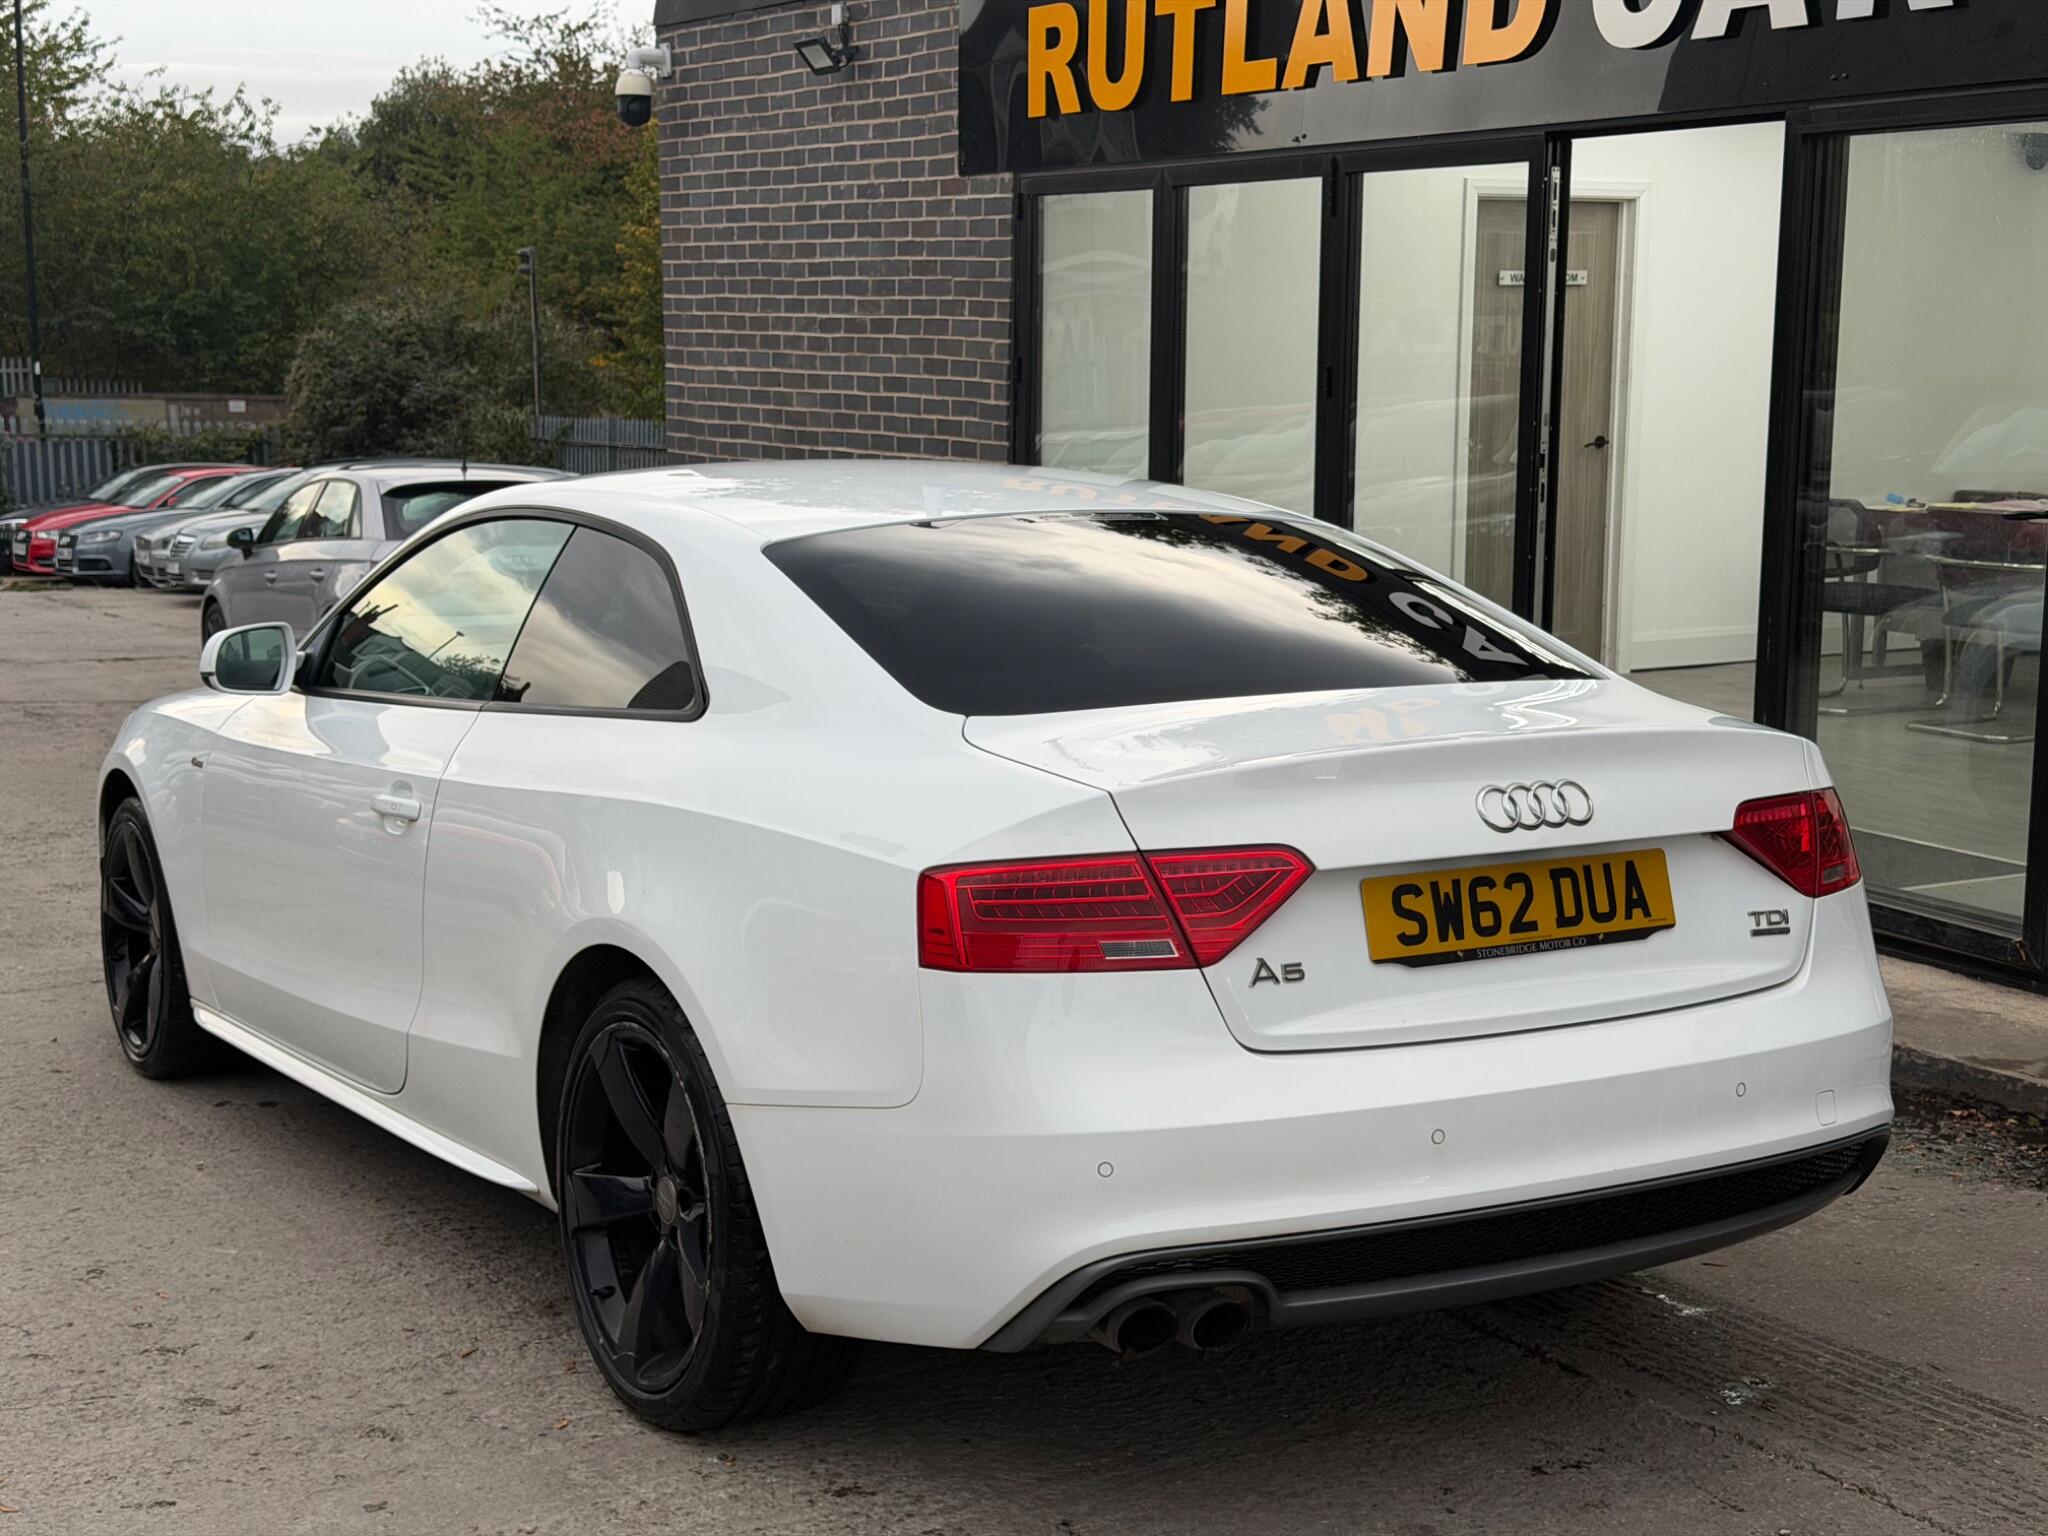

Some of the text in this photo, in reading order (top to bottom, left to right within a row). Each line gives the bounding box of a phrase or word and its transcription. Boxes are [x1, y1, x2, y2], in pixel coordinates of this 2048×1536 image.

[1391, 860, 1652, 946] SW62 DUA
[1476, 936, 1587, 958] STONEBRIDGE MOTOR CO
[1248, 957, 1305, 988] A5
